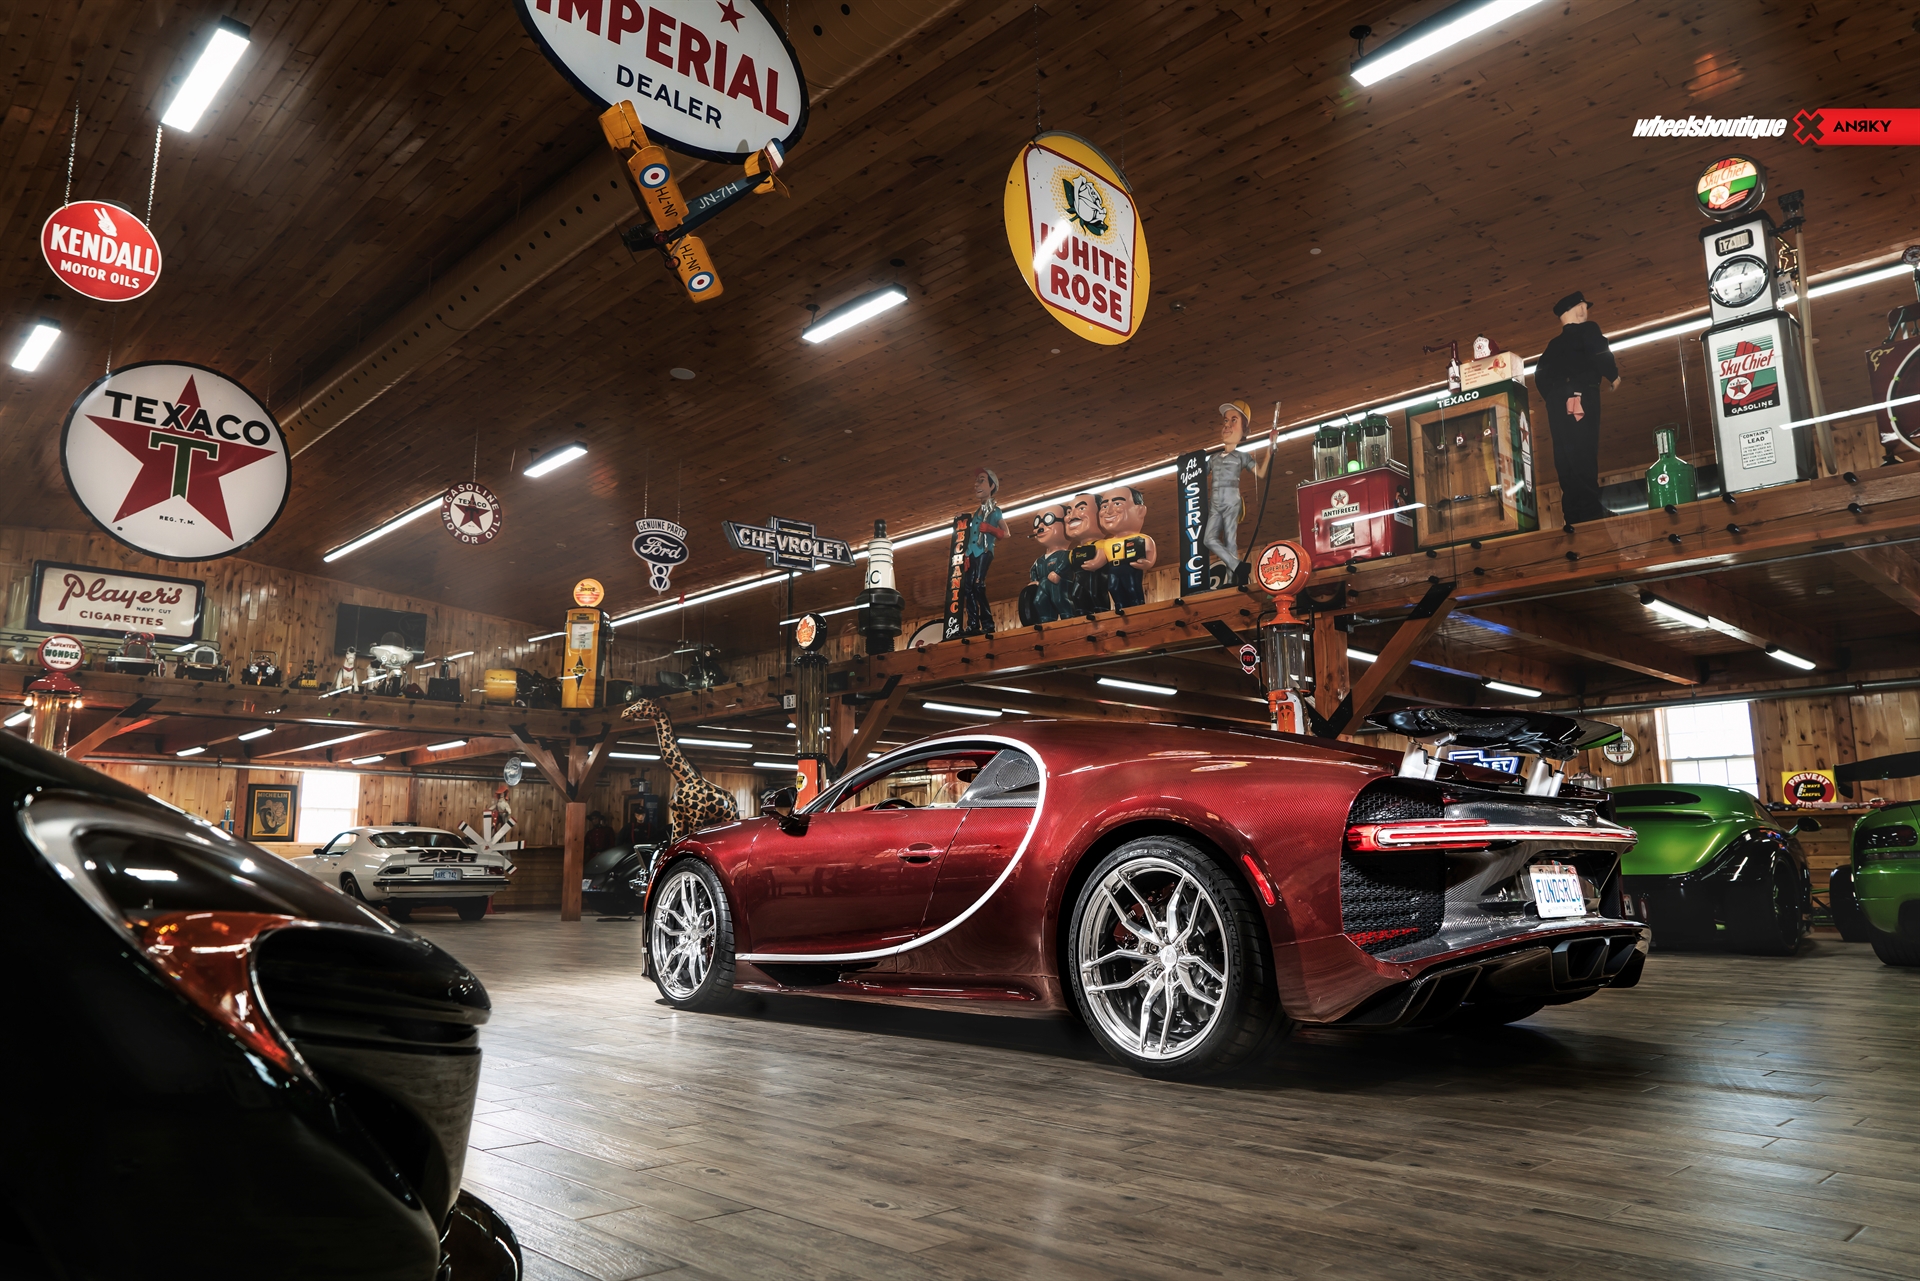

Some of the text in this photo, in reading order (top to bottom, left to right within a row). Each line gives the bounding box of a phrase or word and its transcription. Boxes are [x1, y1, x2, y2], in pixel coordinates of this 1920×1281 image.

[535, 0, 790, 127] MPERIAL
[616, 64, 723, 130] DEALER
[1703, 163, 1748, 189] Sky Chief
[655, 186, 679, 218] JN-7H
[699, 182, 739, 209] JN-7H
[50, 223, 156, 276] KENDALL
[679, 244, 701, 272] JN-7H
[60, 259, 140, 289] MOTOR OILS
[1051, 263, 1123, 323] ROSE
[1719, 349, 1775, 377] Sky Chief
[1437, 391, 1480, 409] TEXACO
[1731, 400, 1774, 415] GASOLINE
[104, 389, 271, 446] TEXACO
[1742, 430, 1769, 439] CONTAINS
[1747, 436, 1765, 444] LEAD
[1180, 467, 1203, 485] Your
[1186, 457, 1198, 472] At
[444, 483, 500, 511] GASOLINE
[159, 515, 177, 523] REG.
[1323, 505, 1359, 518] ANTIFREEZE
[442, 511, 501, 544] MOTOR OIL
[637, 520, 686, 539] GENUINE PARTS
[1184, 482, 1204, 588] SERVICE
[640, 536, 682, 559] Ford
[739, 527, 845, 561] CHEVROLET
[950, 520, 968, 614] MECHANIC
[58, 573, 183, 611] Player's
[79, 610, 164, 626] CIGARETTES
[45, 649, 79, 660] WONDER
[1787, 772, 1830, 787] PREVENT
[1225, 910, 1241, 967] MICHELIN
